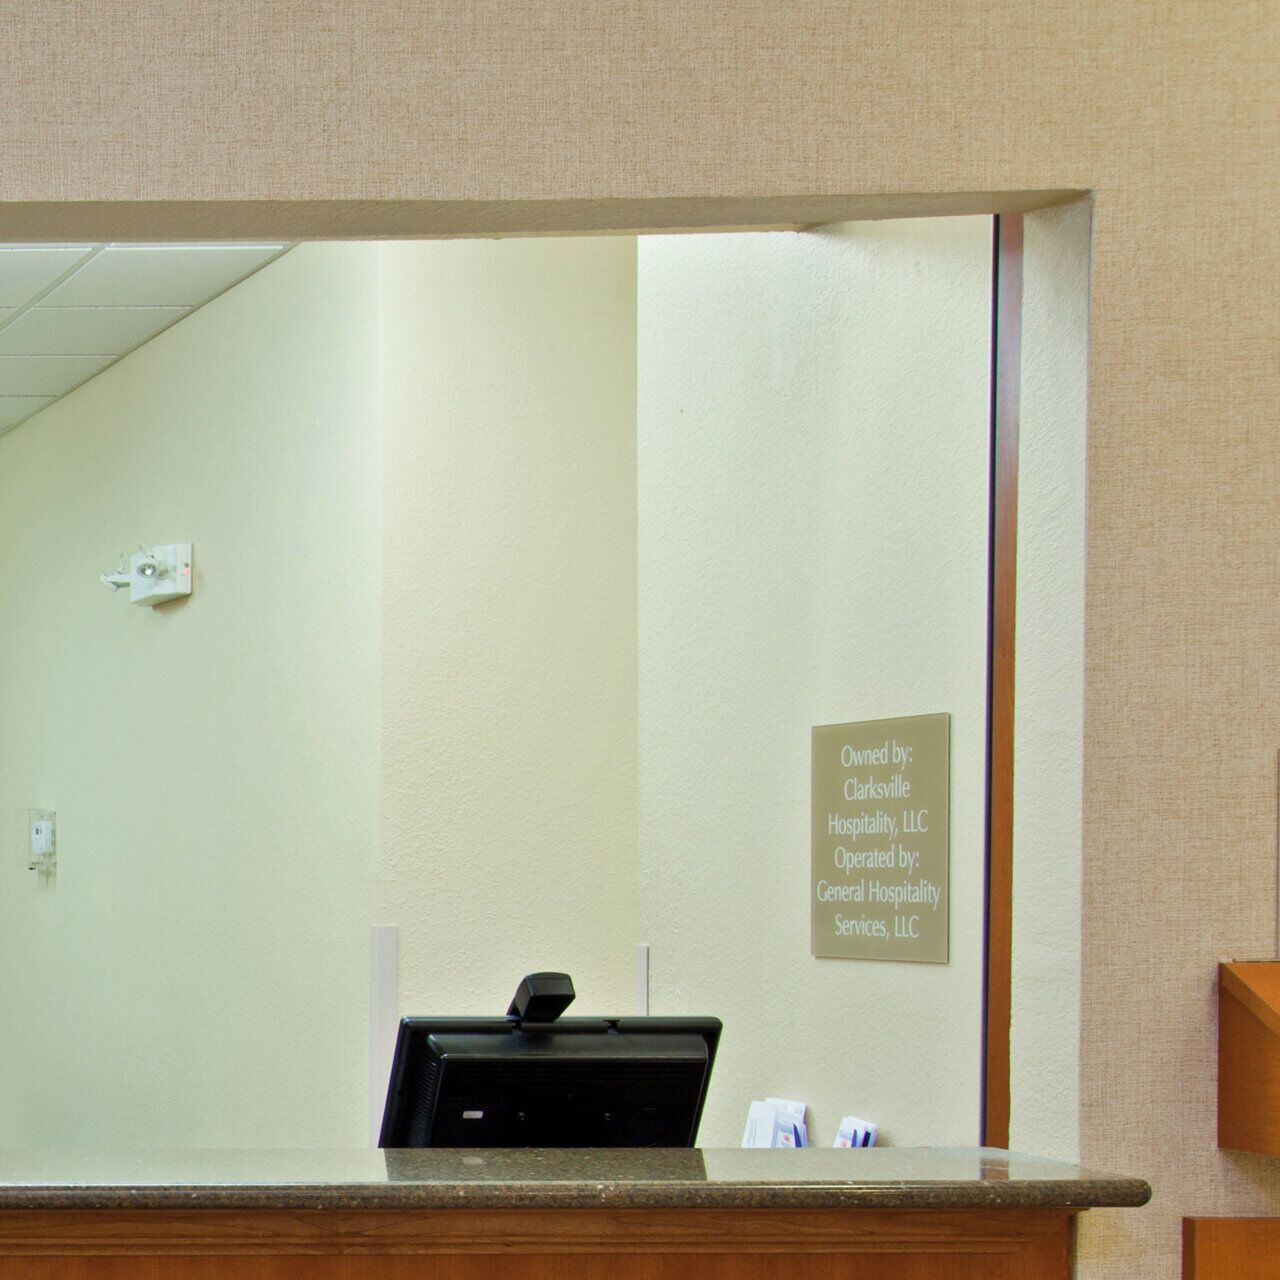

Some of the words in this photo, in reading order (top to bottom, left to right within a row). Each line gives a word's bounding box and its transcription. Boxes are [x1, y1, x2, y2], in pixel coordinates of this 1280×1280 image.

[840, 741, 888, 768] Owned
[892, 740, 913, 770] by:
[844, 774, 910, 801] Clarksville
[828, 811, 899, 841] Hospitality,
[903, 809, 929, 834] LLC
[834, 844, 894, 875] Operated
[899, 844, 920, 875] by:
[817, 880, 864, 904] General
[869, 880, 940, 911] Hospitality
[835, 913, 890, 941] Services,
[895, 915, 920, 939] LLC
